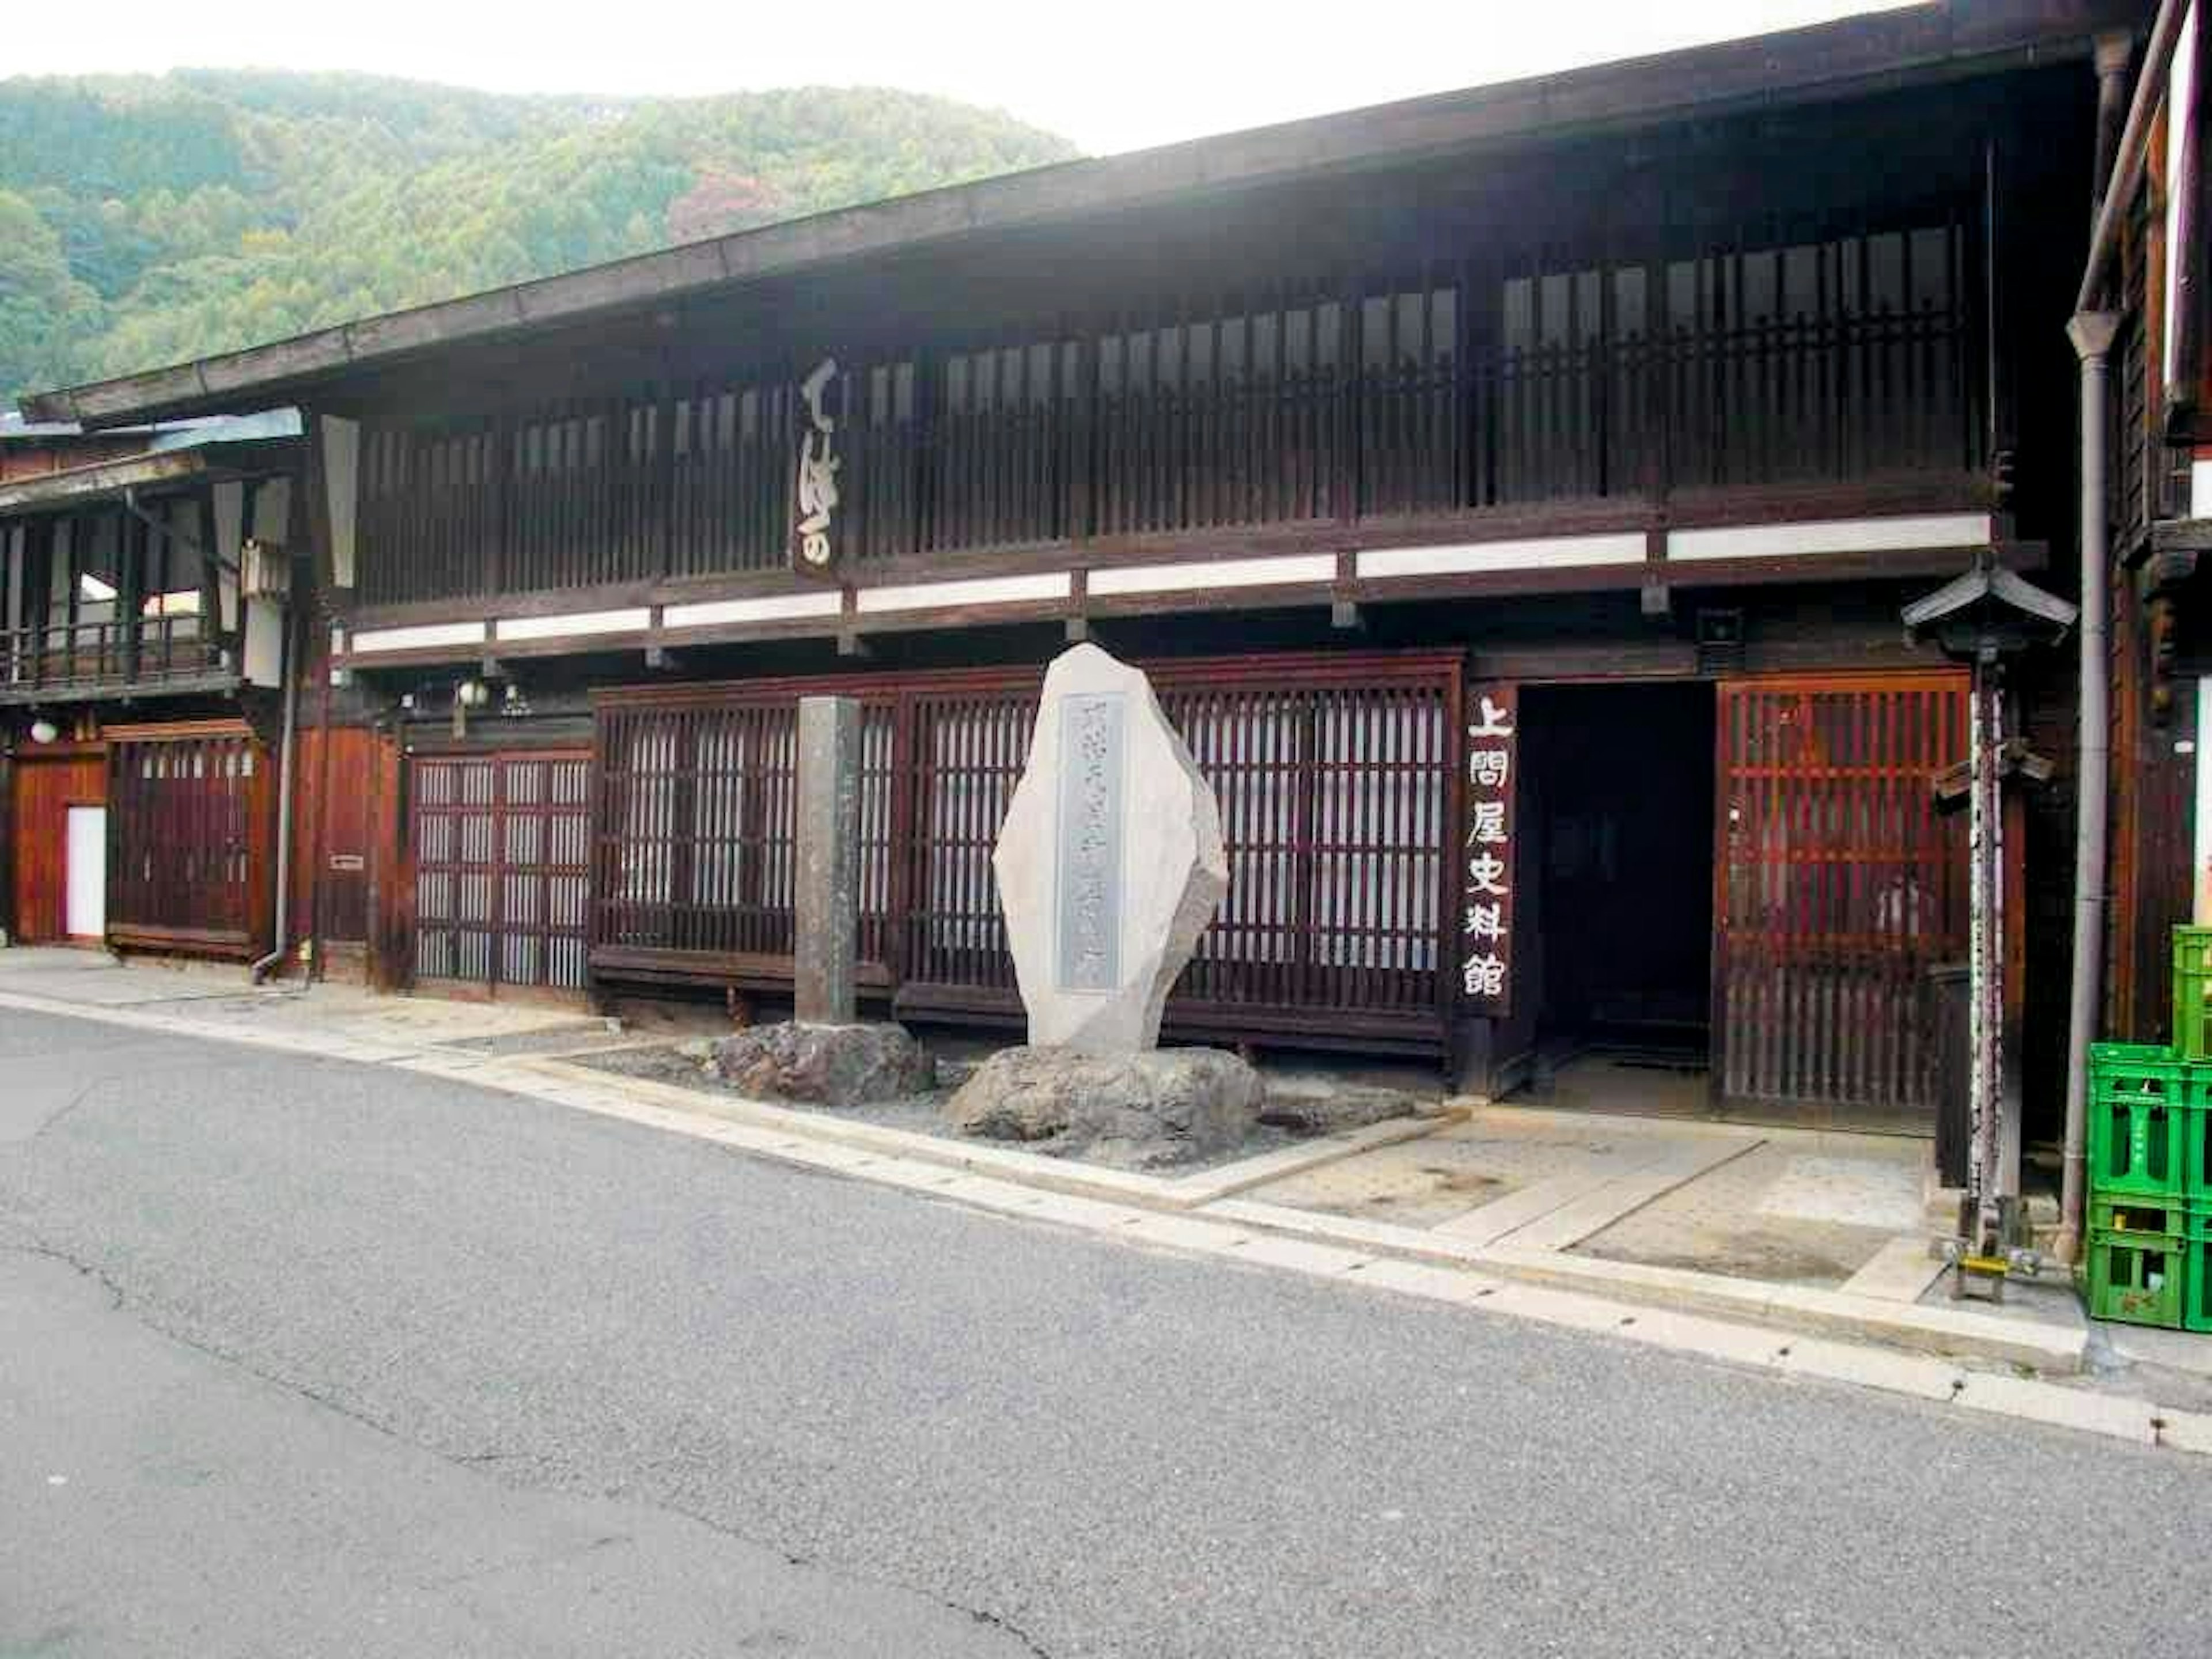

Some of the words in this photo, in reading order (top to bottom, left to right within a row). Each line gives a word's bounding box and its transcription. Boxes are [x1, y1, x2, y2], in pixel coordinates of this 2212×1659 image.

[1462, 697, 1514, 996] 上問屋史料館
